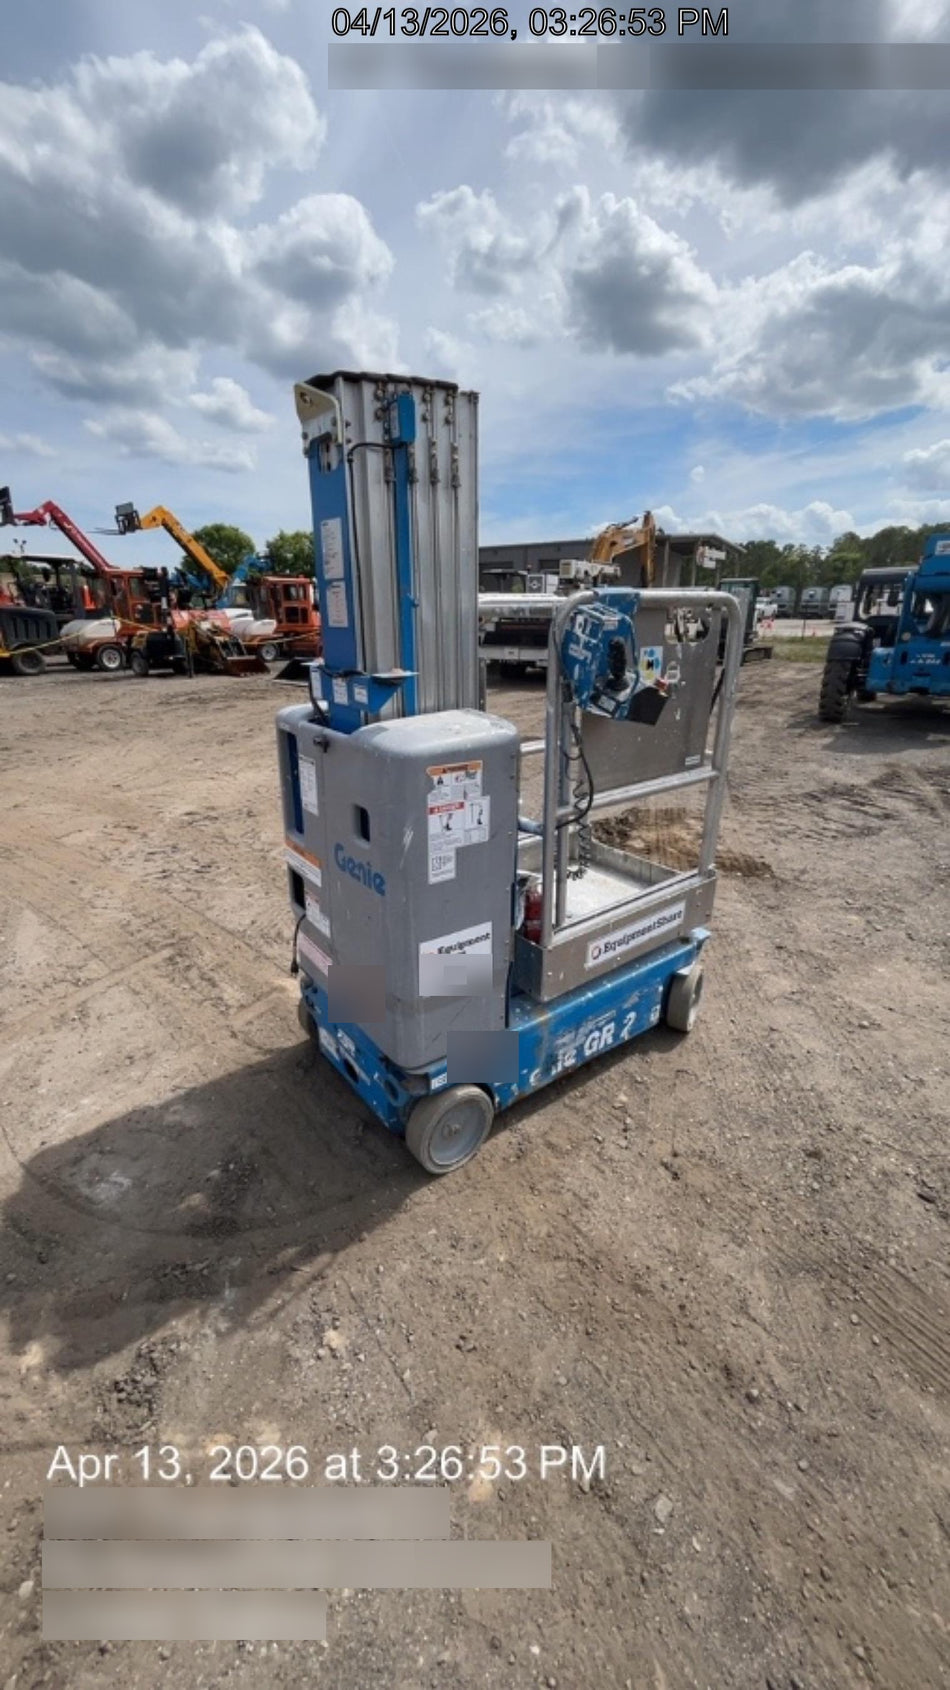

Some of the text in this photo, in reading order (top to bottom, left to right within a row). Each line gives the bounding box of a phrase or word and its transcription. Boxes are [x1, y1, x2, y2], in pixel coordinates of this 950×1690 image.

[334, 842, 386, 896] Genie
[437, 932, 491, 954] Equipment
[603, 910, 682, 954] EquipmentShare
